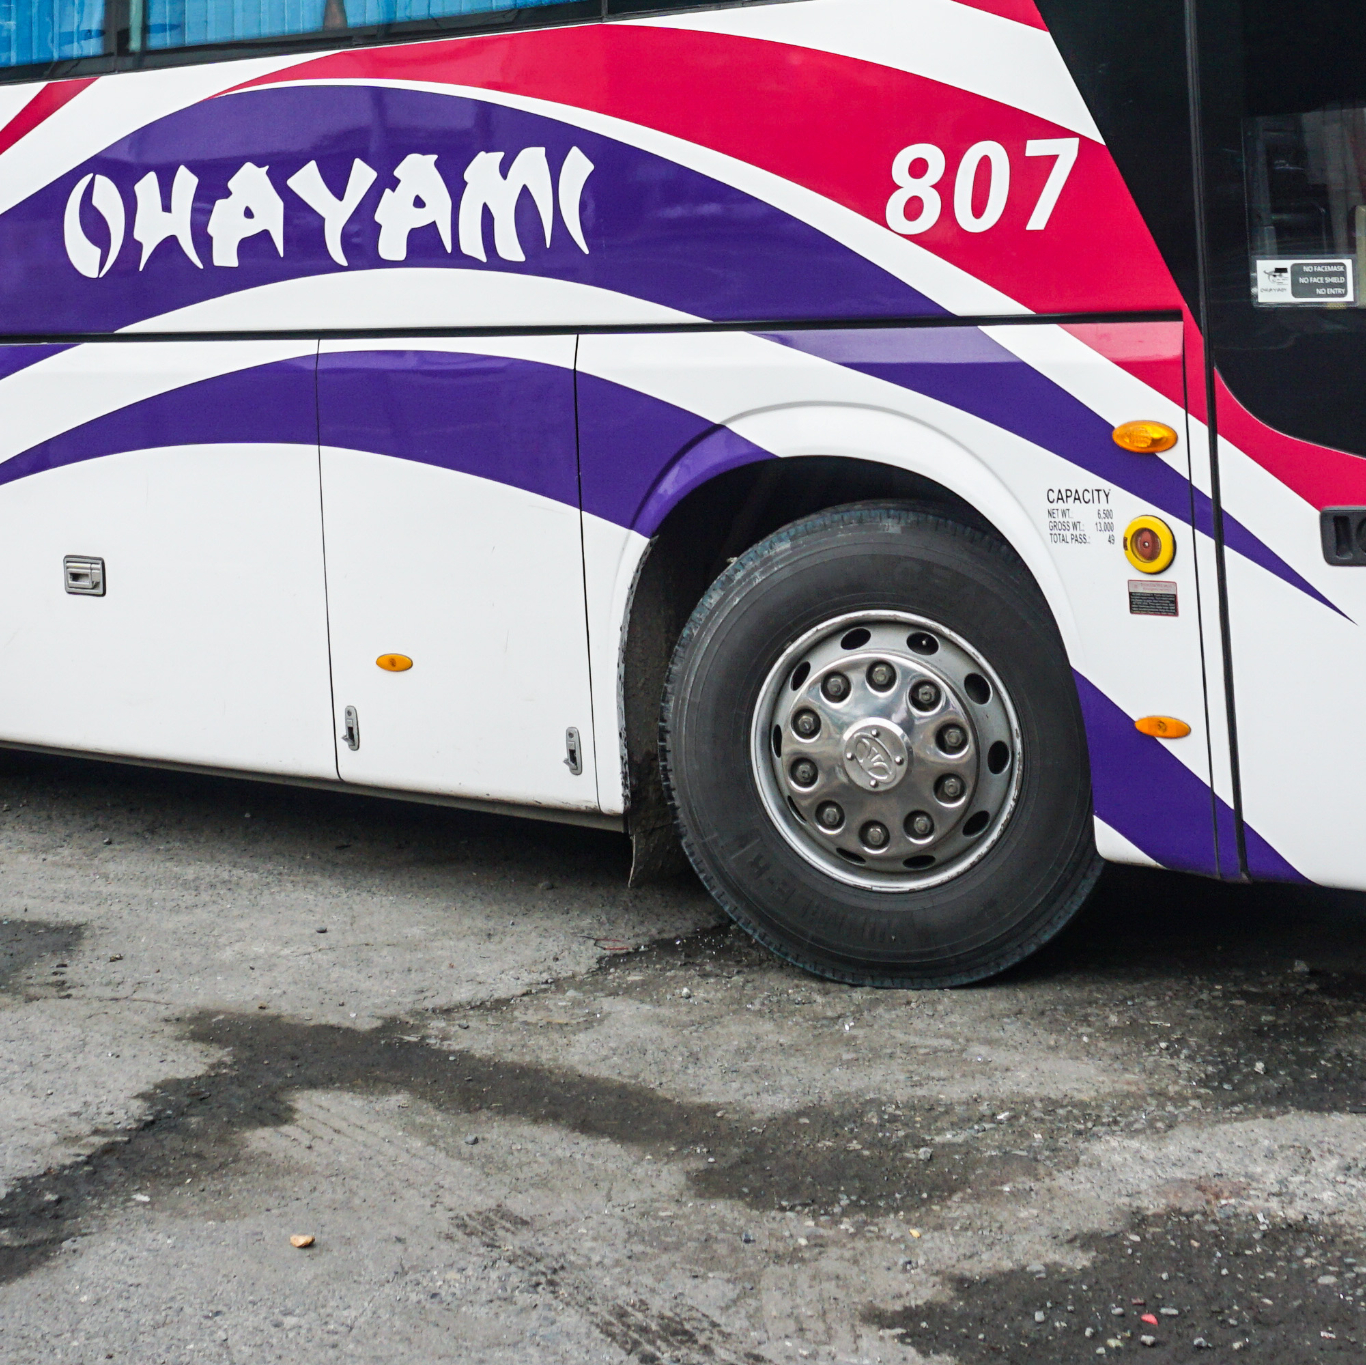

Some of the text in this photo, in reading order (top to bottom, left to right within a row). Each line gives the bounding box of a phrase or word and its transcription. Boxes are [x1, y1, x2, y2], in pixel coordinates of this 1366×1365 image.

[885, 137, 1080, 235] 807
[63, 145, 595, 279] OHAYAMI
[1303, 265, 1313, 273] NO
[1309, 276, 1324, 284] FACE
[1046, 488, 1111, 505] CAPACITY
[1047, 508, 1059, 519] NET
[1097, 509, 1114, 520] 6,500
[1048, 520, 1070, 532] GROSS
[1049, 533, 1069, 544] TOTAL
